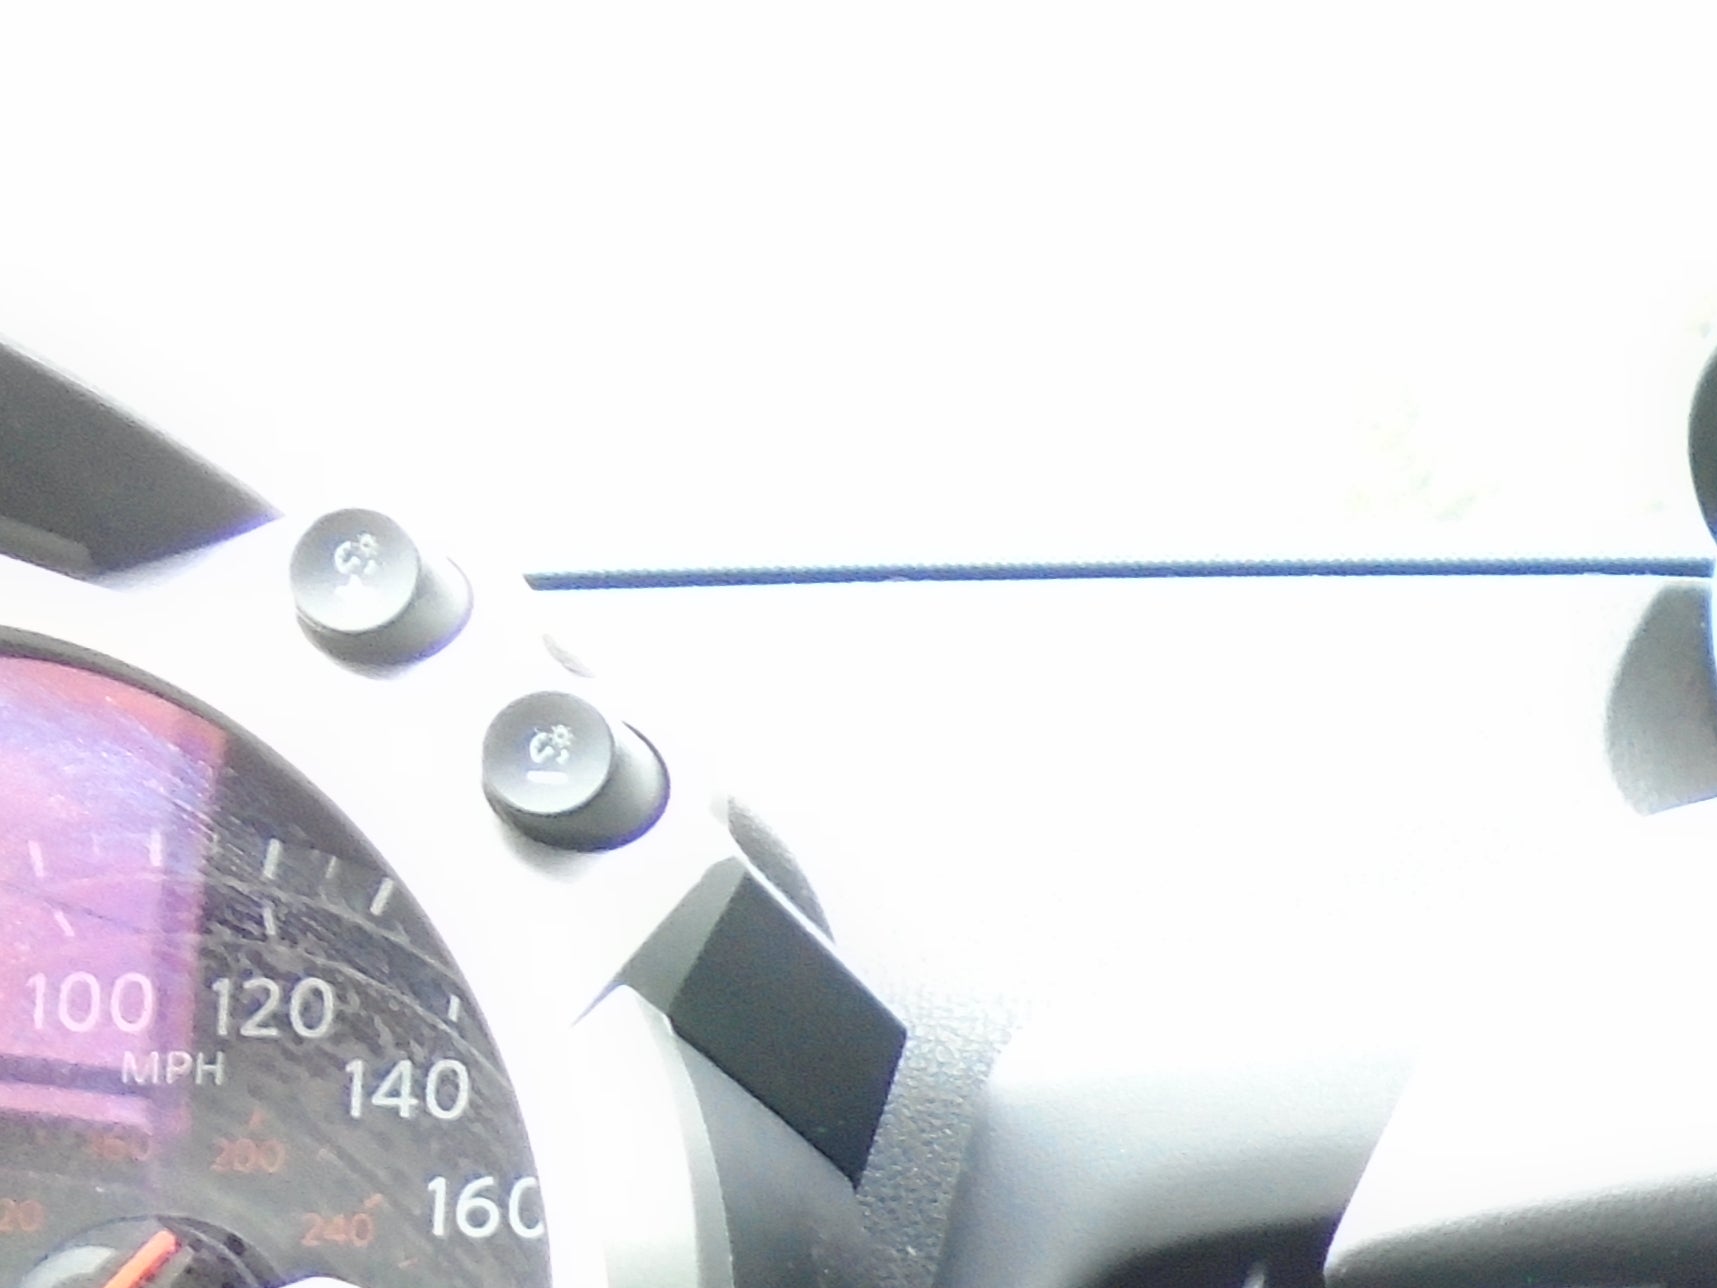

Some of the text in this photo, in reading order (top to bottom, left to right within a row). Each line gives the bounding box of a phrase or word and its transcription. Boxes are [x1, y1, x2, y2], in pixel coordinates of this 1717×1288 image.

[26, 971, 154, 1033] 100
[211, 976, 335, 1039] 120
[120, 1050, 227, 1086] MPH
[345, 1058, 471, 1120] 140
[210, 1137, 286, 1174] 200
[300, 1211, 375, 1248] 240
[427, 1175, 546, 1239] 160
